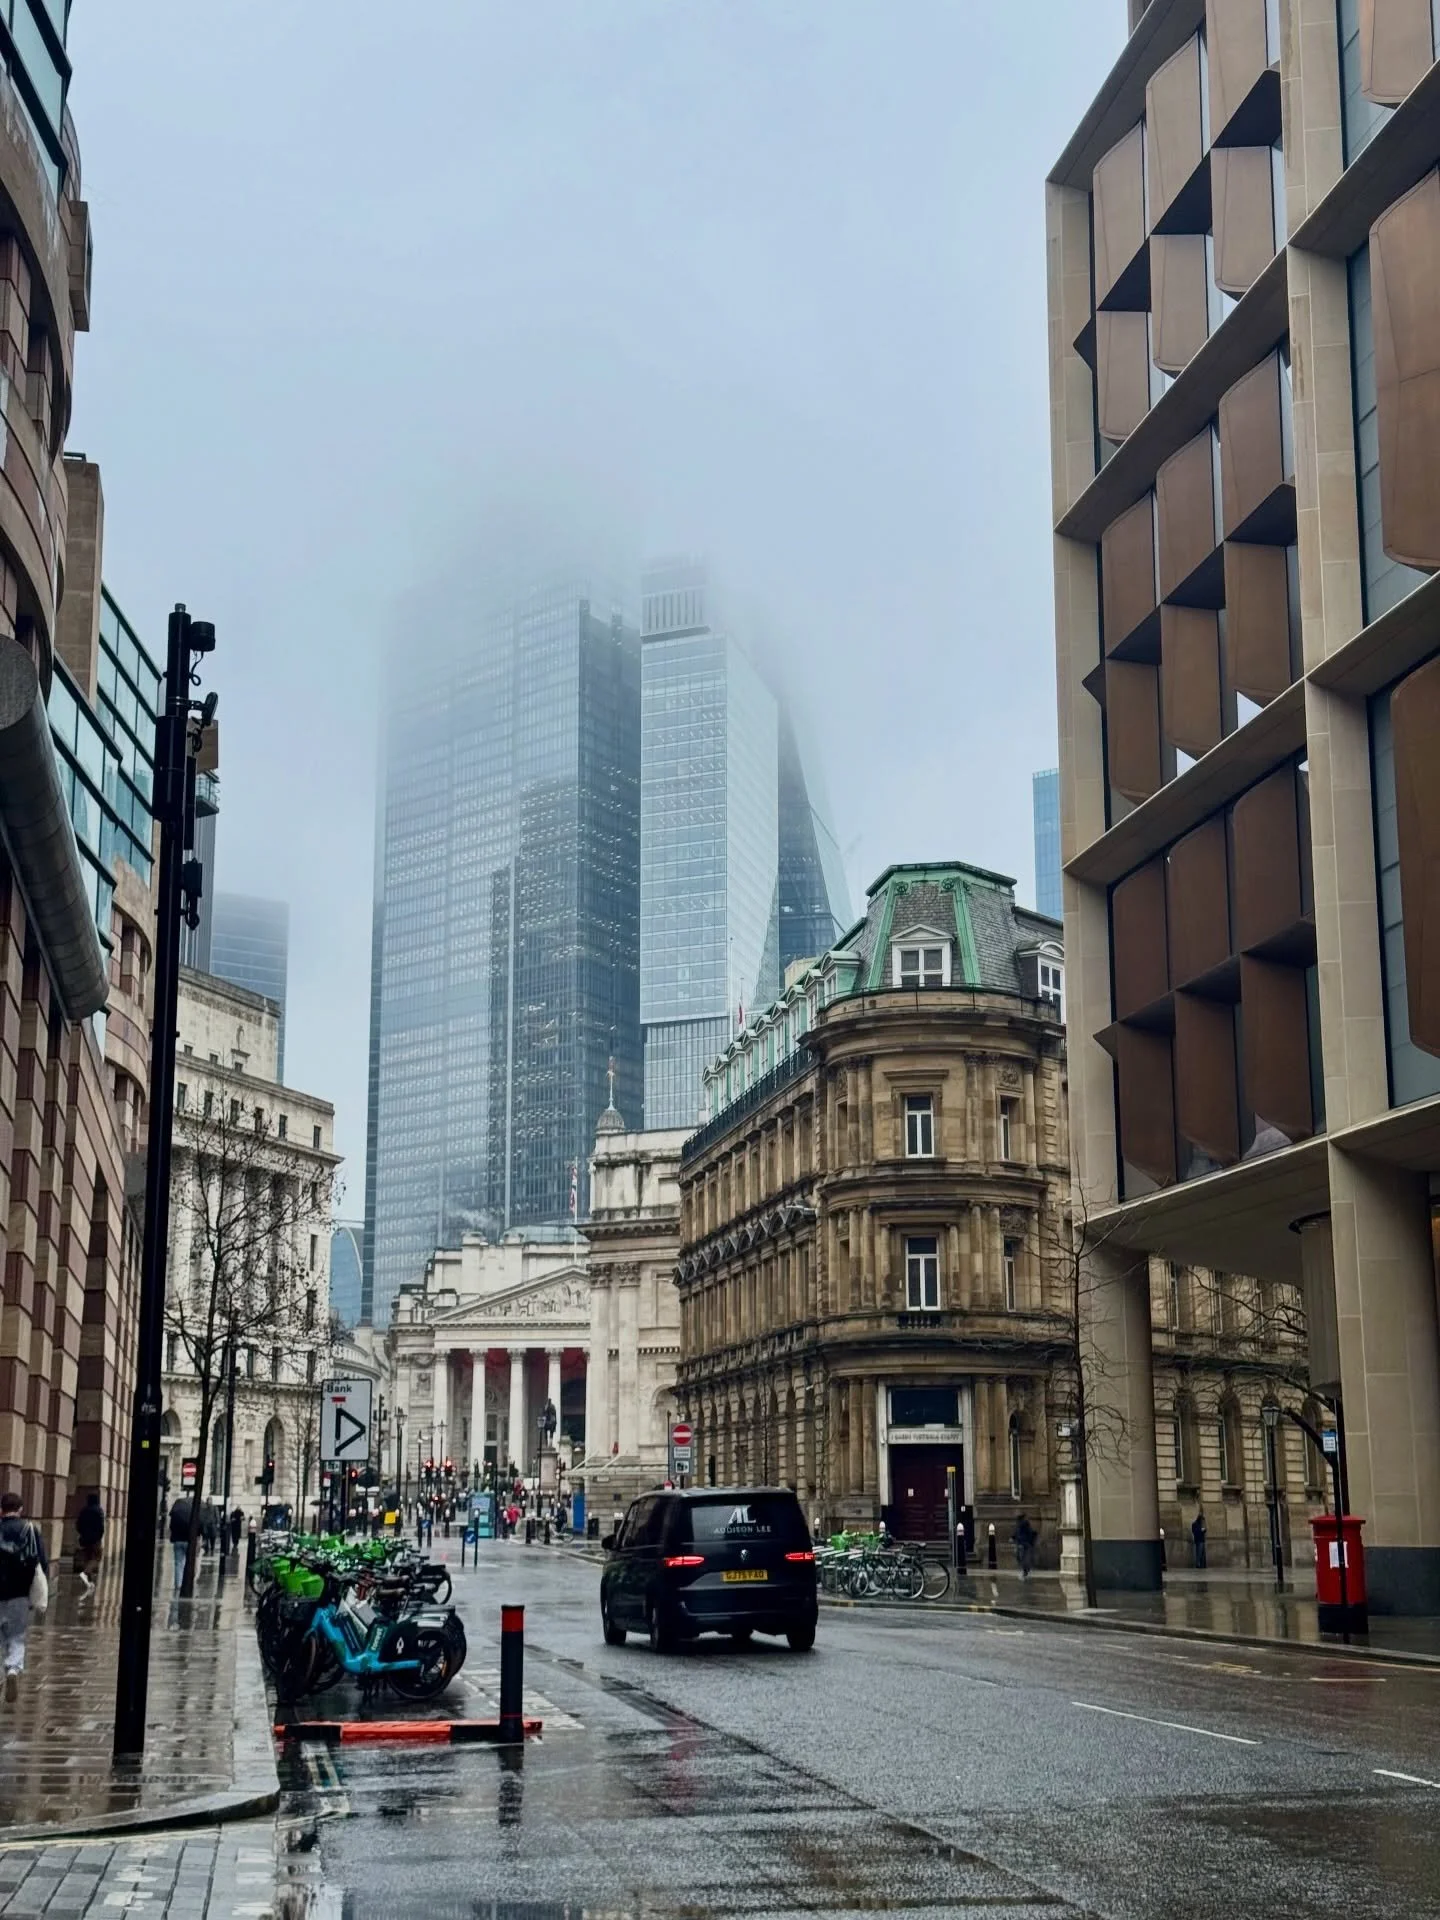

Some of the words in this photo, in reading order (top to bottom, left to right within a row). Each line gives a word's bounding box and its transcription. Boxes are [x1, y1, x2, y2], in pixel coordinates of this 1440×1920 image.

[327, 1383, 353, 1393] Bank
[713, 1526, 753, 1534] ADDISON
[756, 1525, 772, 1533] LEE
